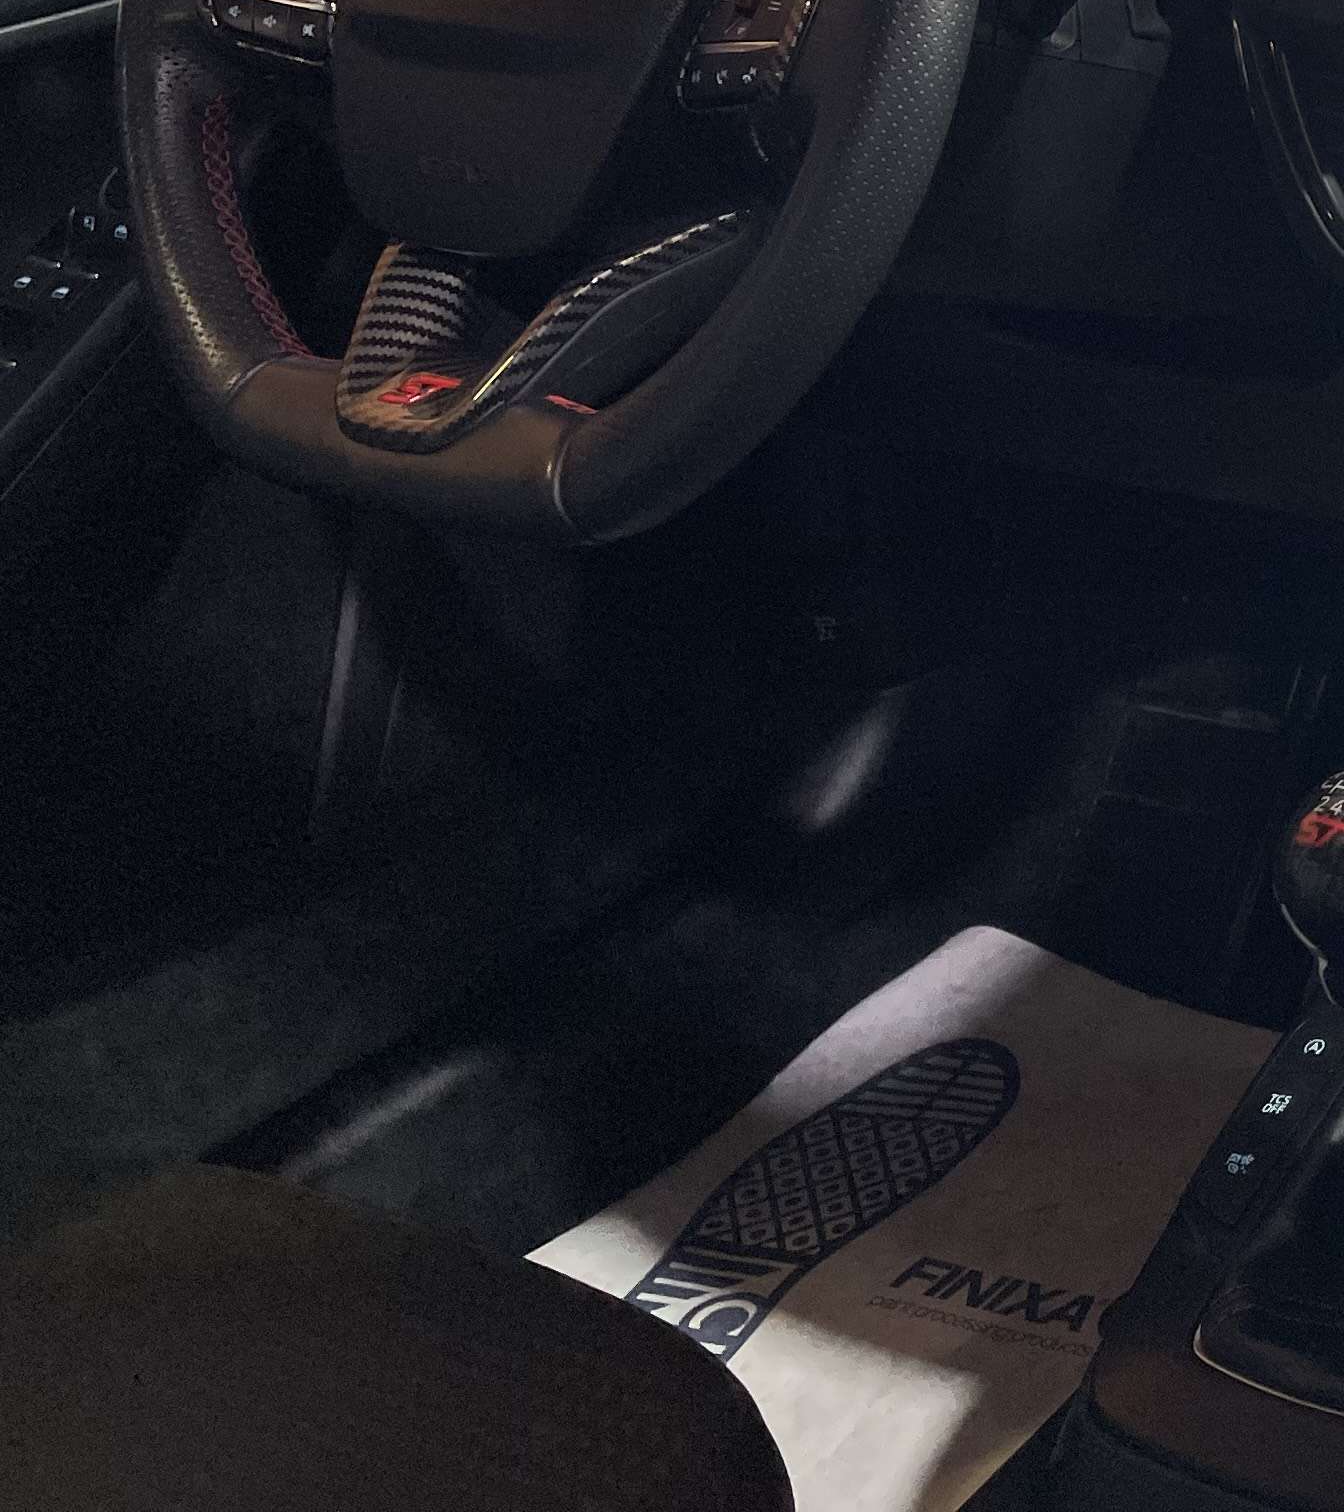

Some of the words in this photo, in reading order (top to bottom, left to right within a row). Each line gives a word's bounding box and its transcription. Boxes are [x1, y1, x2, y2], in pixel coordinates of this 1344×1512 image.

[1269, 1093, 1292, 1105] TCS
[1261, 1103, 1288, 1115] OFF
[889, 1256, 1096, 1333] FINIXA
